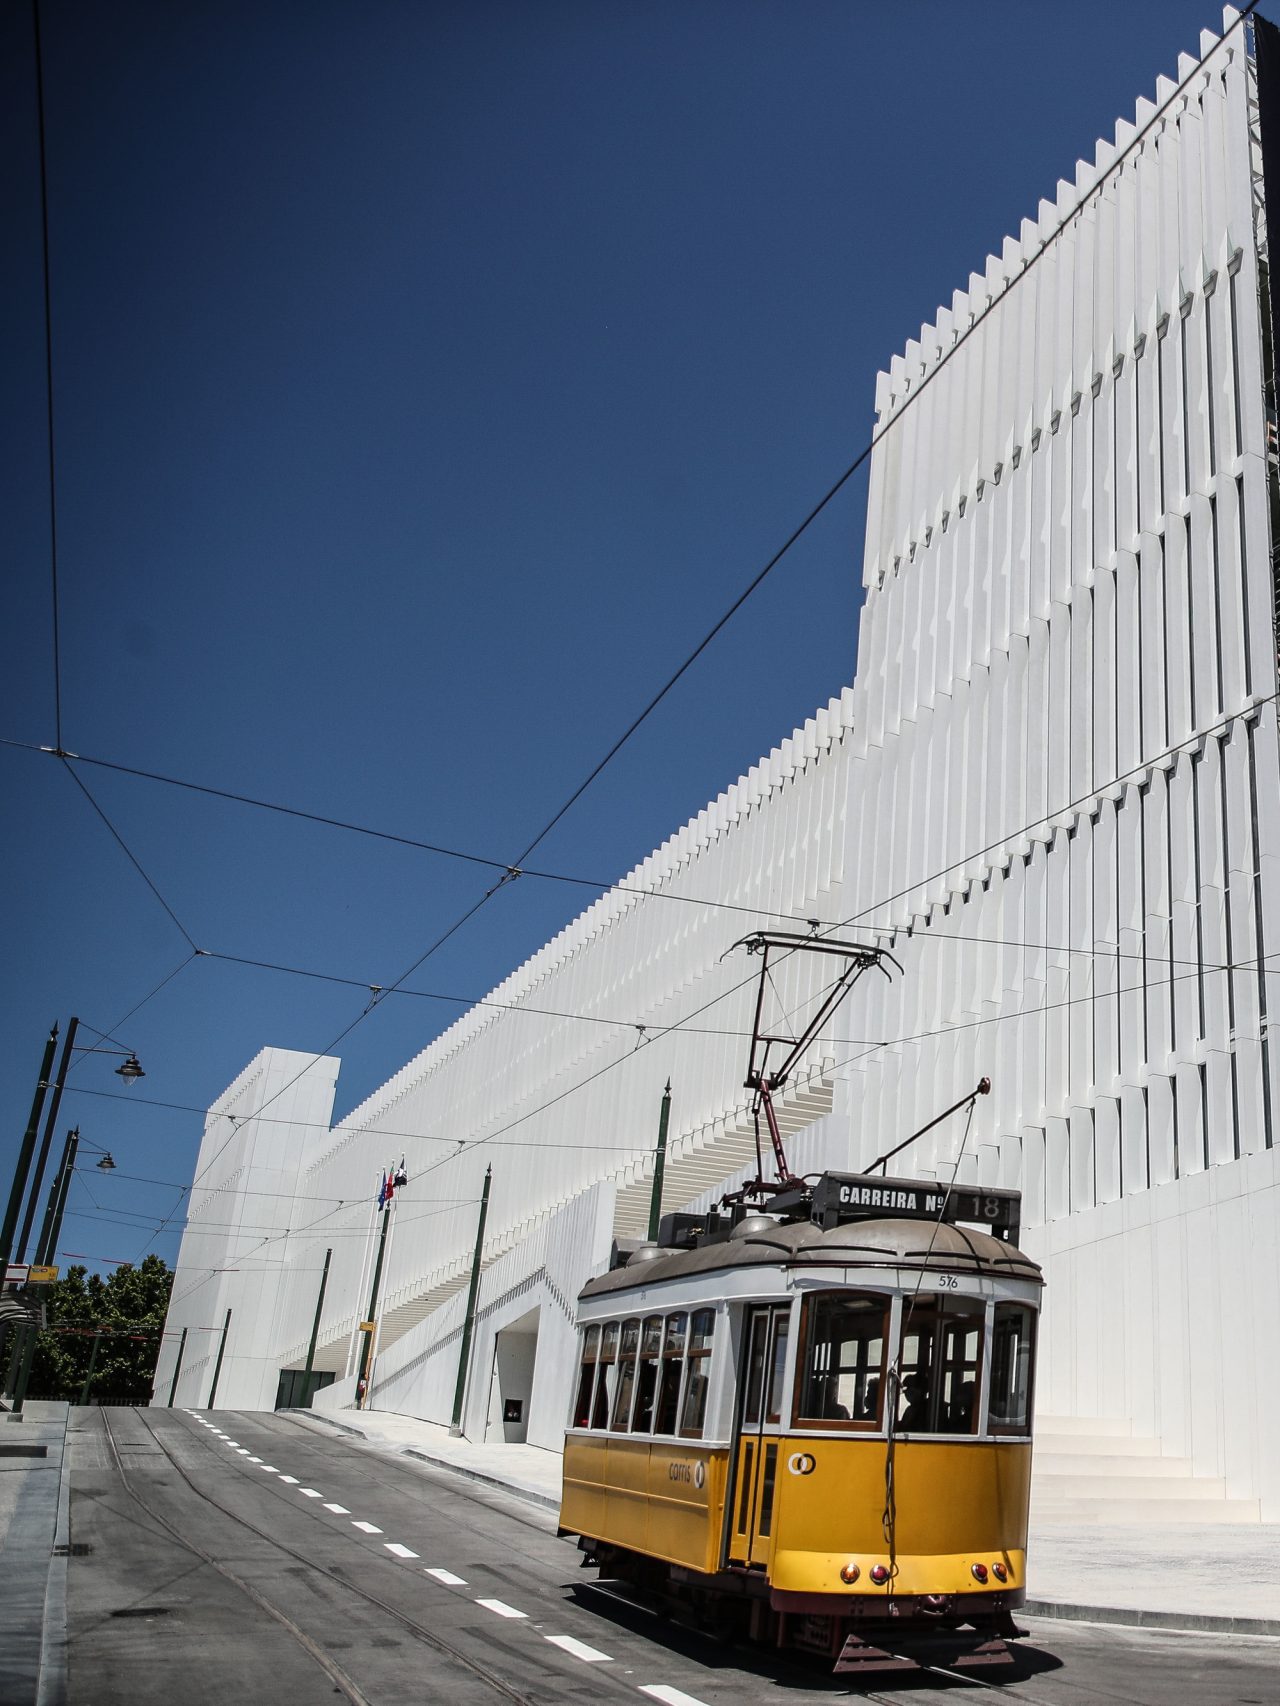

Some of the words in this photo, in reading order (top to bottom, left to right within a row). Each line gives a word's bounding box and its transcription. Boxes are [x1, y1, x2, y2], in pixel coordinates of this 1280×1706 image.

[839, 1186, 917, 1210] CARREIRA
[939, 1275, 958, 1288] 576
[669, 1463, 691, 1482] carris
